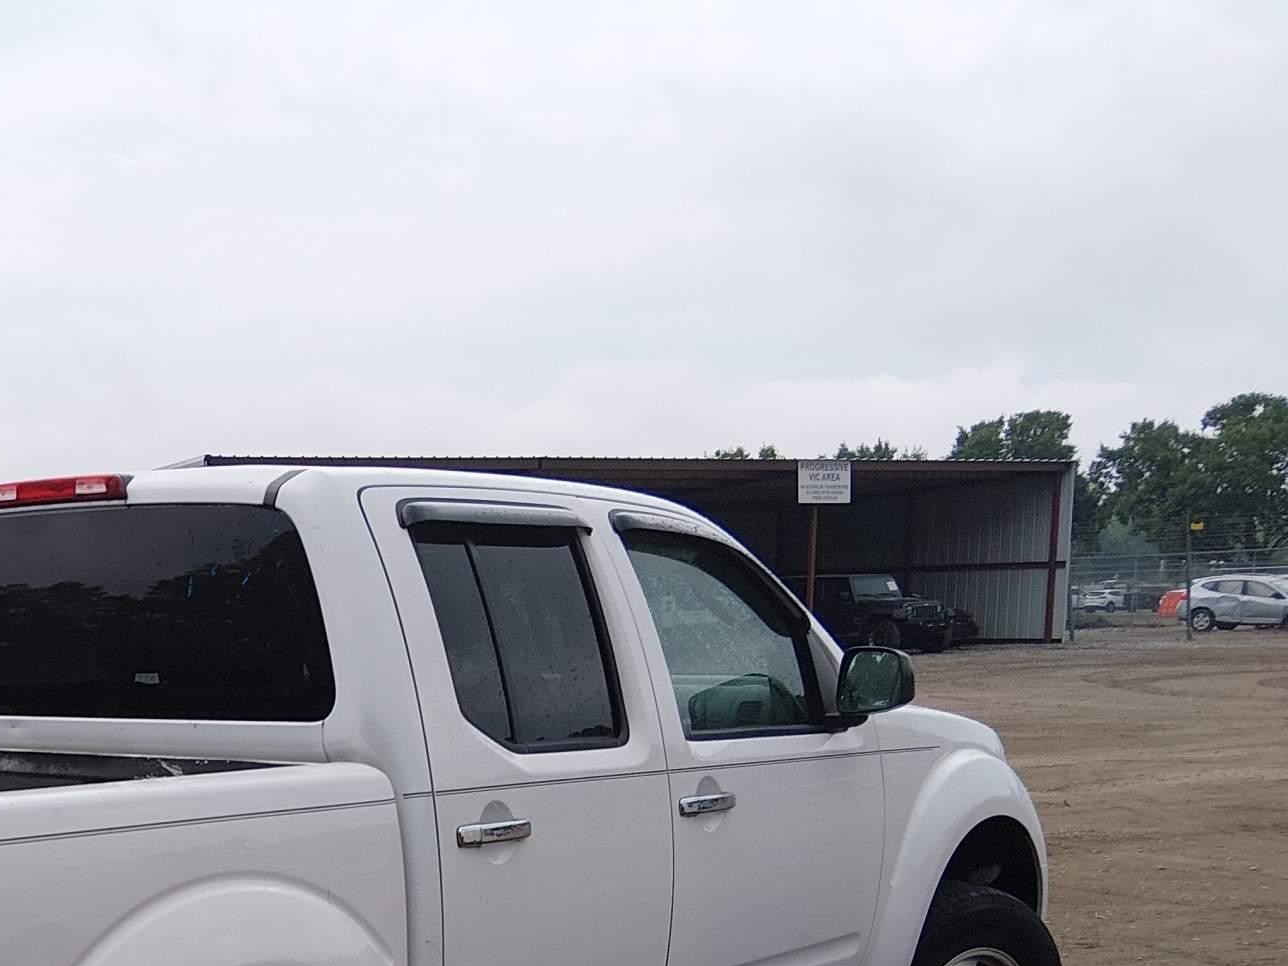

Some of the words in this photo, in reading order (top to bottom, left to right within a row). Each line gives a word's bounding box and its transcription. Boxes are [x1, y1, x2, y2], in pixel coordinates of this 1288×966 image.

[800, 462, 849, 471] PROGRESSIVE
[808, 472, 821, 481] VIC
[821, 472, 841, 482] AREA
